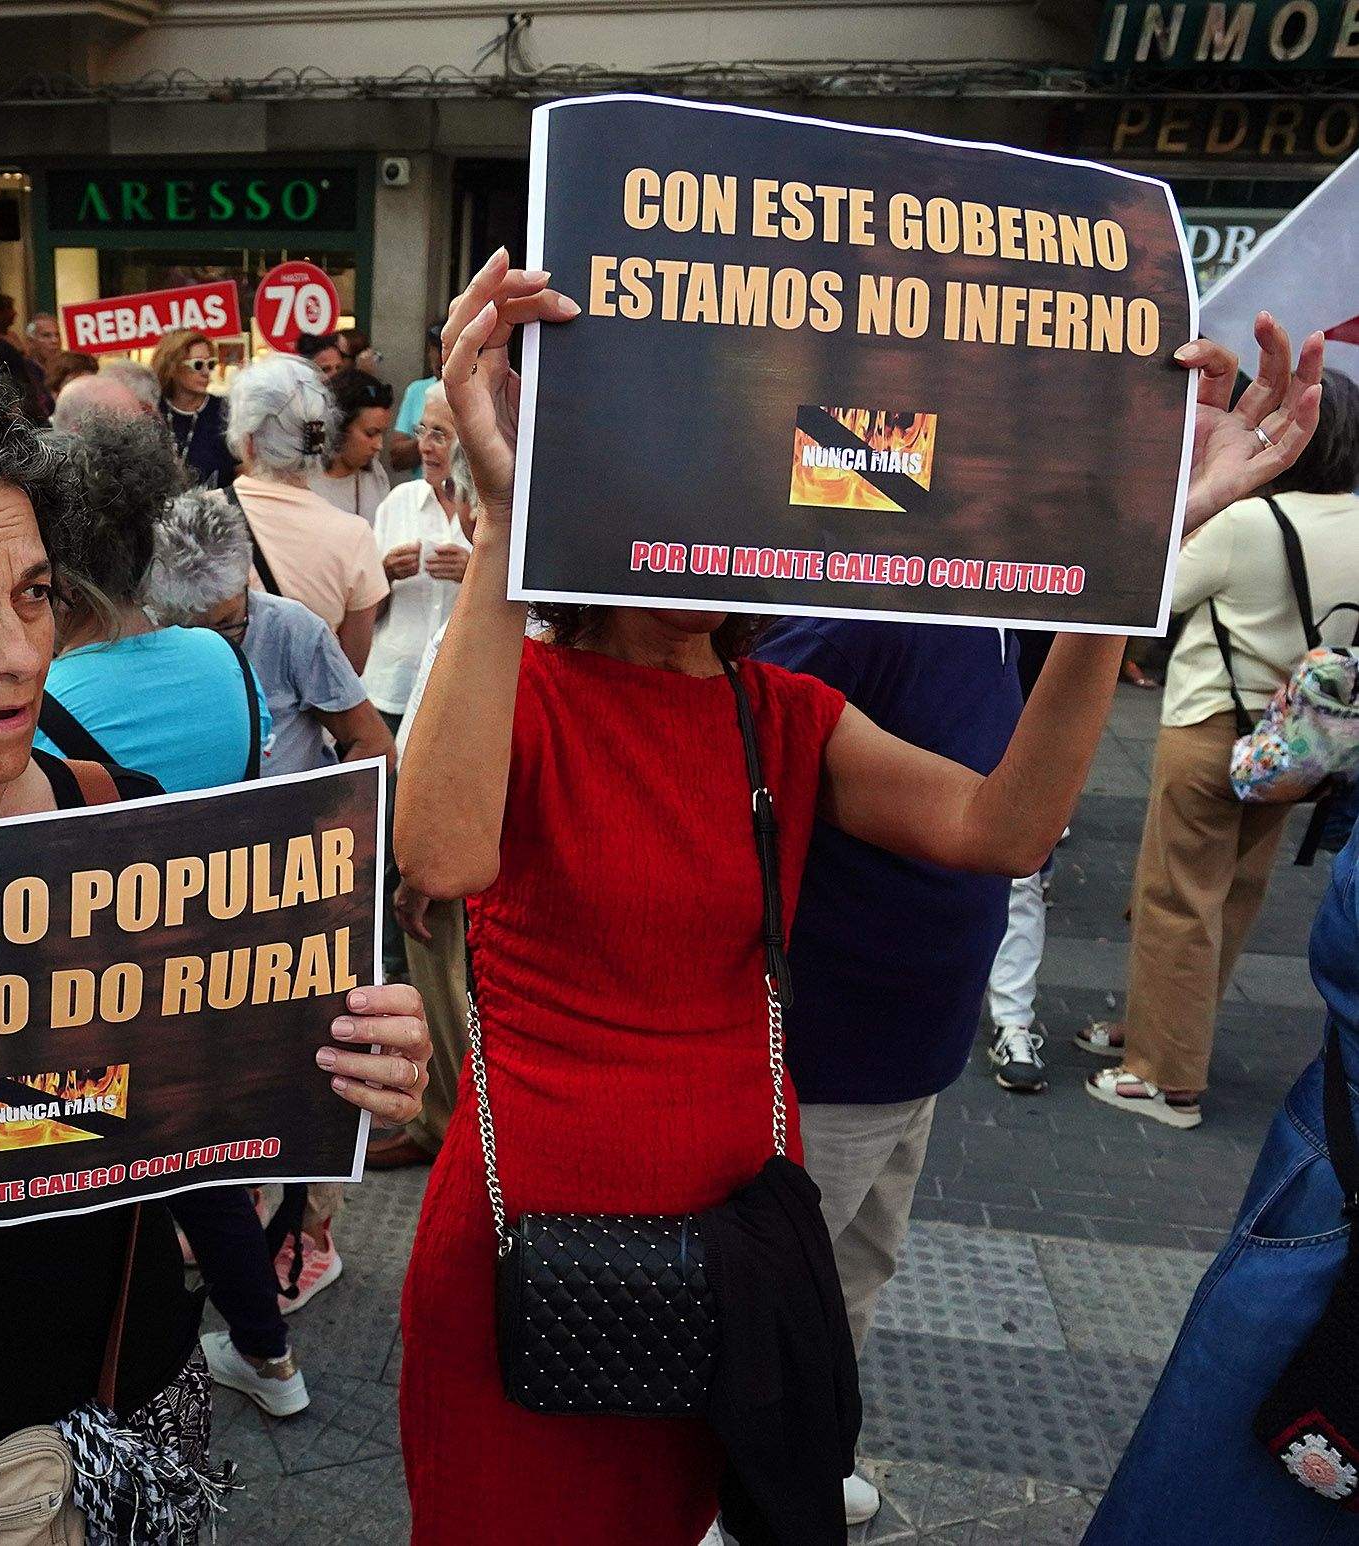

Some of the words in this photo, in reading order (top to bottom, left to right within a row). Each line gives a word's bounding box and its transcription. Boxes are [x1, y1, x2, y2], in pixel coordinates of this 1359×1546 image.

[77, 179, 318, 222] ARESSO
[623, 167, 737, 235] CON
[752, 179, 875, 248] ESTE
[888, 193, 1127, 271] GOBERNO
[74, 294, 227, 346] REBAJAS
[265, 283, 332, 337] 70
[589, 255, 844, 334] ESTAMOS
[856, 274, 930, 339] NO
[943, 281, 1160, 357] INFERNO
[802, 445, 867, 472] NUNCA
[870, 450, 922, 475] MAIS
[630, 541, 687, 574] POR
[690, 545, 730, 576] UN
[733, 547, 824, 581] MONTE
[827, 551, 923, 588] GALEGO
[928, 557, 985, 590] CON
[986, 561, 1086, 596] FUTURO
[70, 826, 357, 939] POPULAR
[50, 962, 145, 1030] DO
[161, 927, 358, 1018] RURAL
[64, 1094, 119, 1117] MAIS
[28, 1164, 127, 1199] GALEGO
[128, 1153, 185, 1181] CON
[185, 1136, 282, 1170] FUTURO
